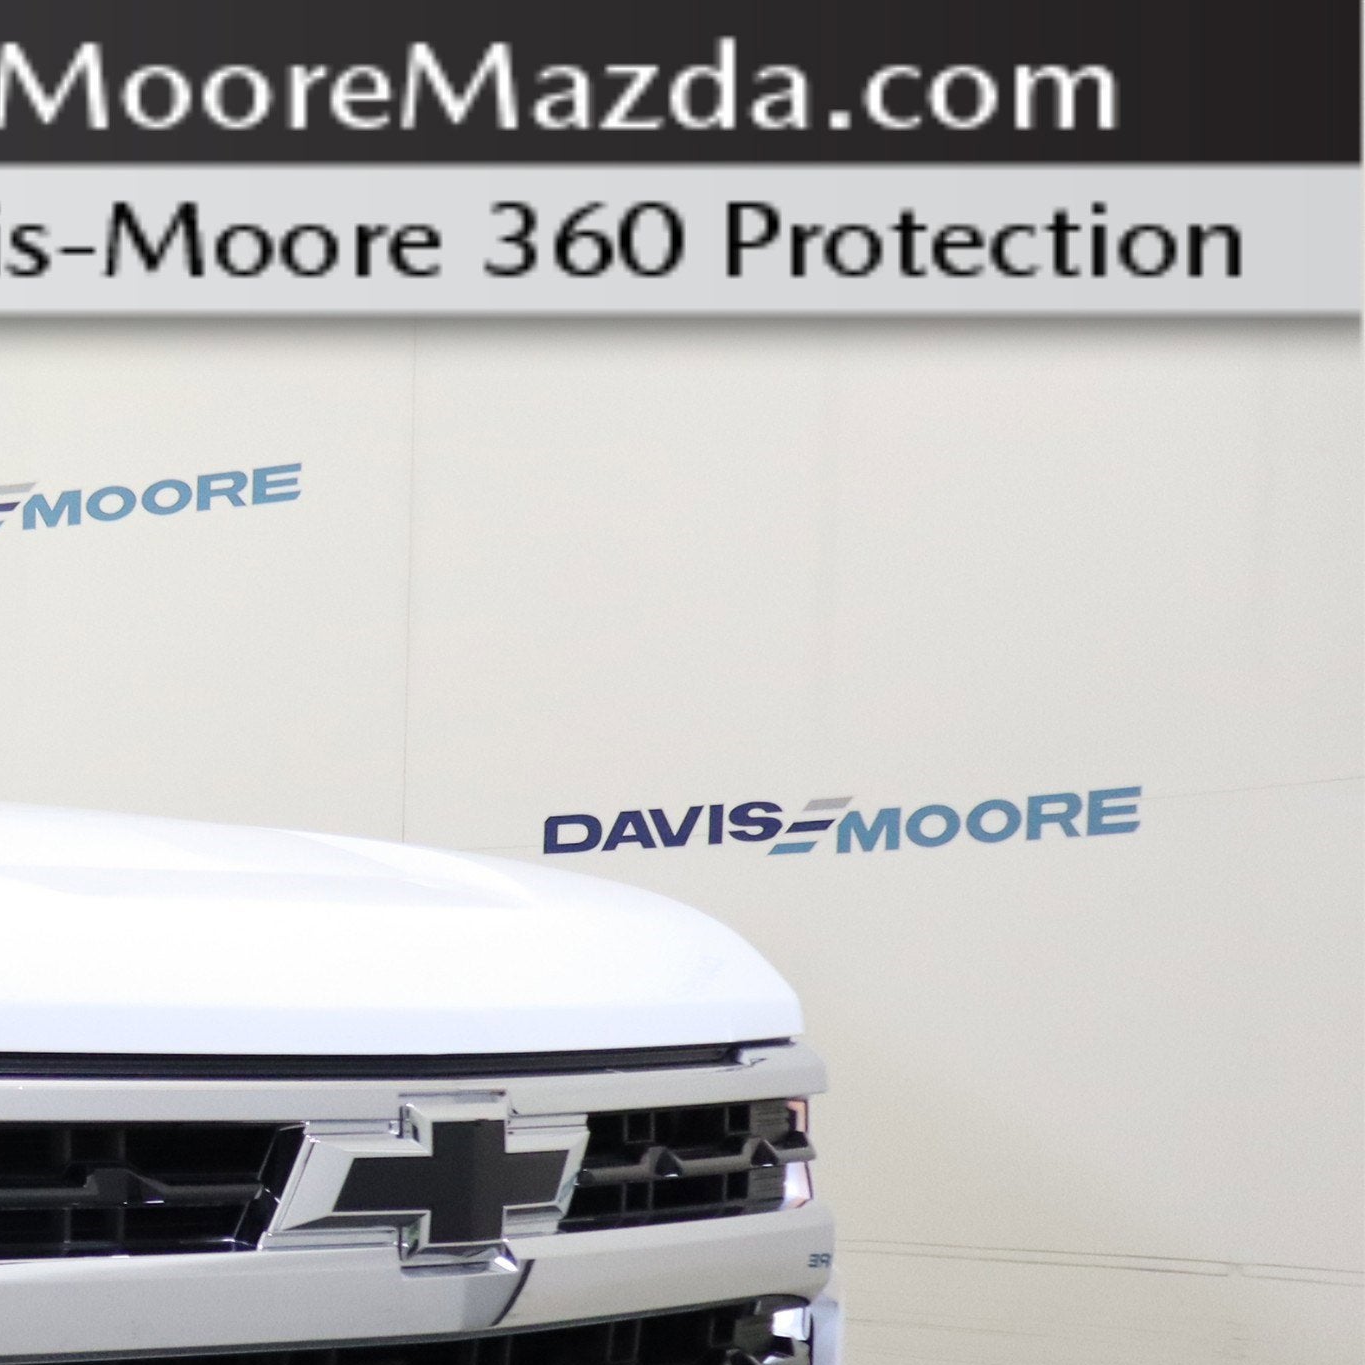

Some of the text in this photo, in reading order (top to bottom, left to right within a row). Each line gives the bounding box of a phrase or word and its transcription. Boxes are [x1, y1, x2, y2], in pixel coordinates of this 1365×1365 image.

[22, 462, 302, 531] MOORE
[542, 785, 1142, 855] DAVIS MOORE
